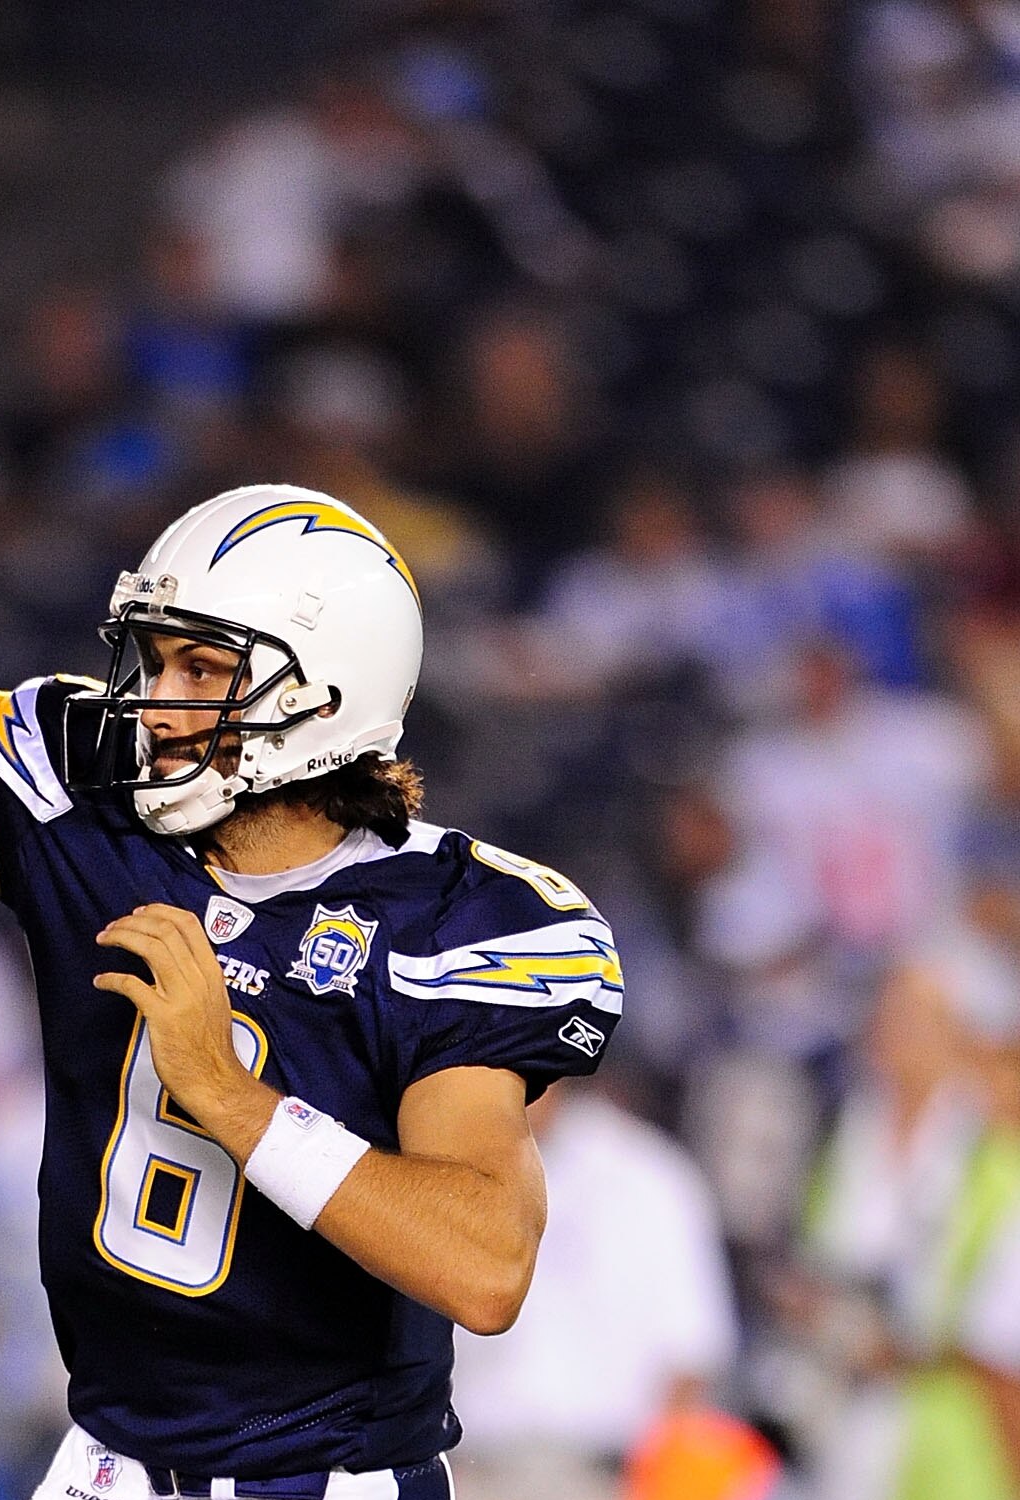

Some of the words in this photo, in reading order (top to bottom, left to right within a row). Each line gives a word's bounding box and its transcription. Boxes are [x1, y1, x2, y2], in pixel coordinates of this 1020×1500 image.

[212, 919, 232, 938] NFL
[311, 937, 354, 972] 50
[93, 1009, 268, 1298] 6
